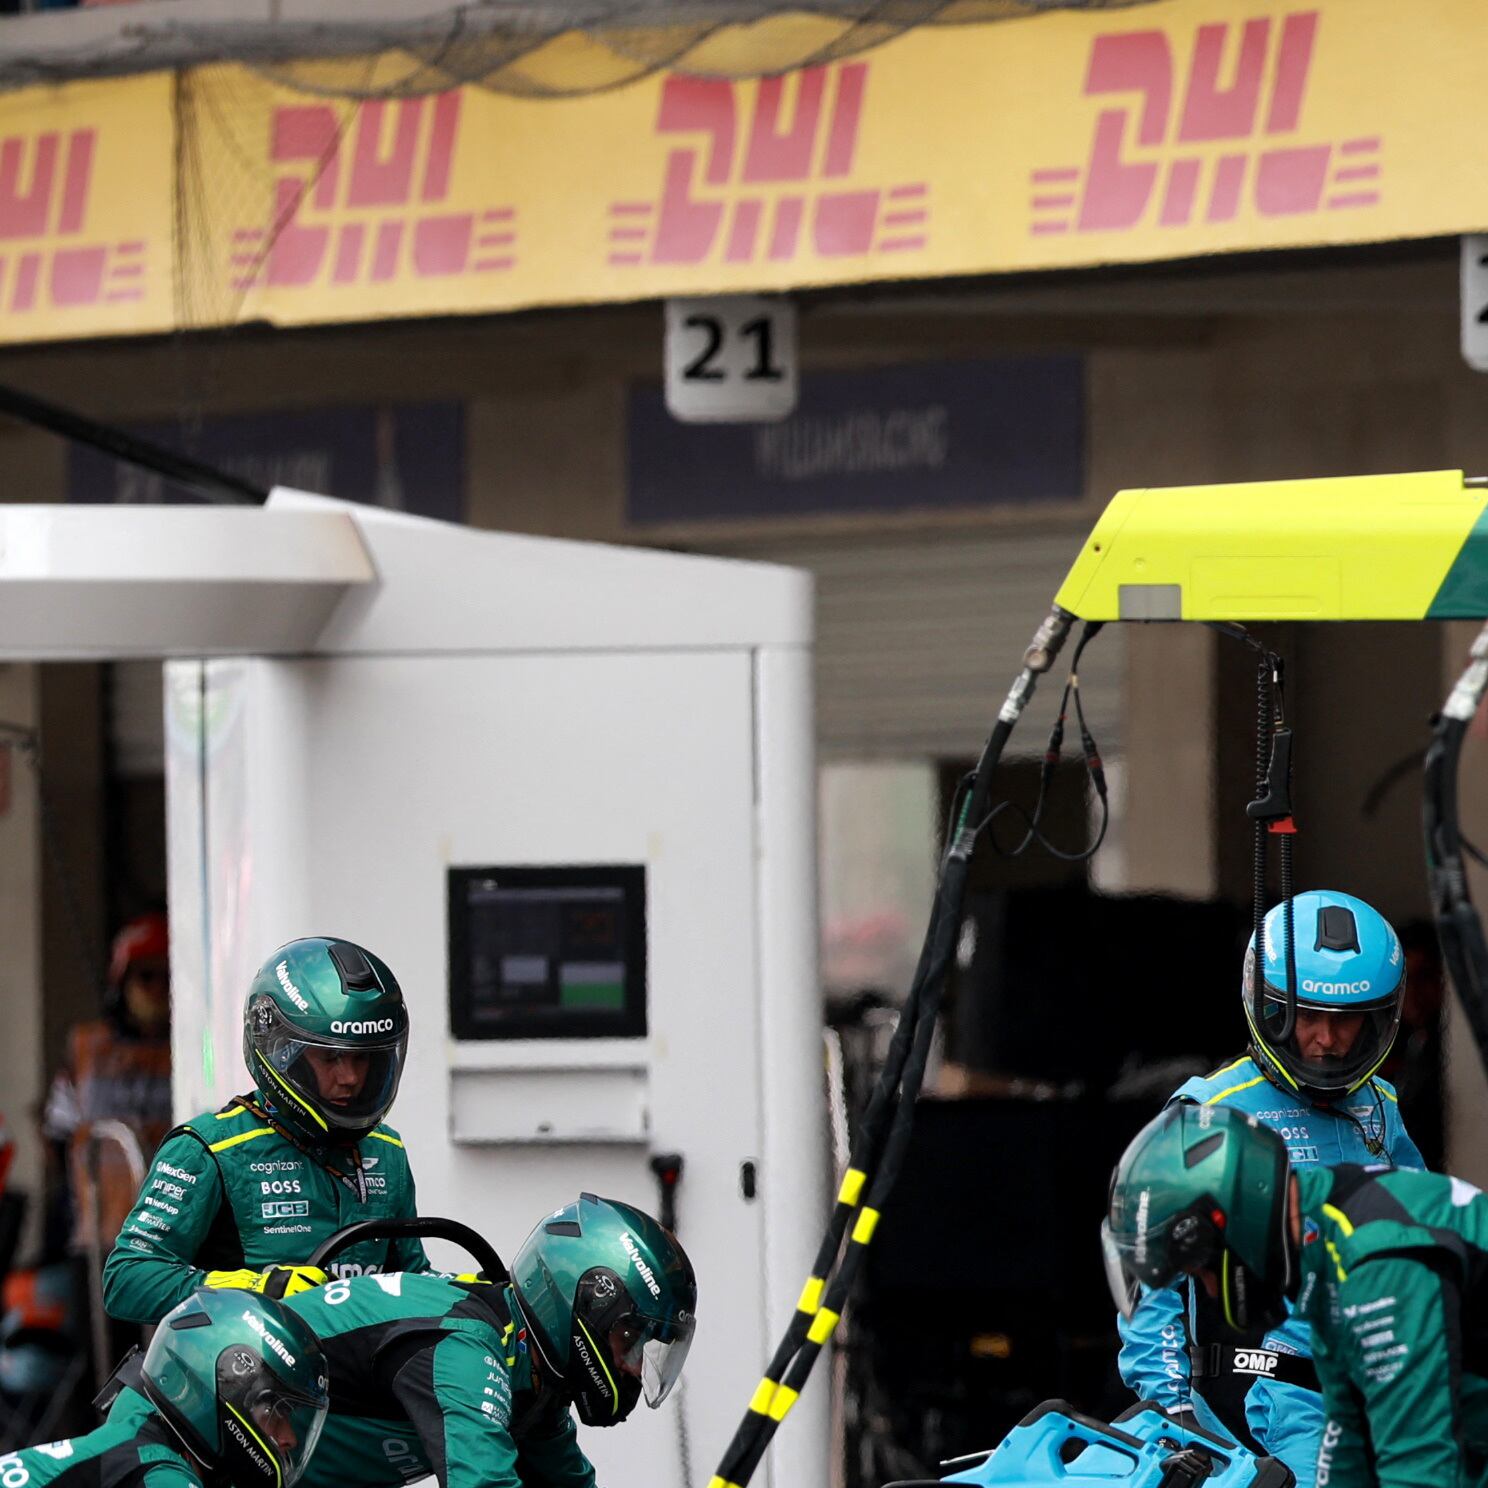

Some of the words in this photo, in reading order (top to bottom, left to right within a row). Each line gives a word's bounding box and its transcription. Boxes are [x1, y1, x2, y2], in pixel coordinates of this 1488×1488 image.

[1078, 11, 1334, 233] DHL
[650, 61, 881, 266] DHL
[266, 90, 476, 288] DHL
[0, 128, 107, 314] HL
[682, 314, 784, 383] 21
[1302, 980, 1370, 995] aramco
[330, 1018, 394, 1035] aramco
[258, 1064, 278, 1091] ASTON
[277, 1089, 307, 1117] MARTIN
[1280, 1127, 1309, 1140] OSS
[161, 1163, 197, 1184] NexGen
[261, 1180, 301, 1194] BOSS
[263, 1202, 308, 1217] JCB
[264, 1224, 312, 1234] SentinelOne
[573, 1335, 592, 1371] ASTON
[589, 1366, 611, 1398] MARTIN
[1233, 1351, 1278, 1374] OMP
[225, 1419, 250, 1448] ASTON
[247, 1446, 274, 1477] MARTIN
